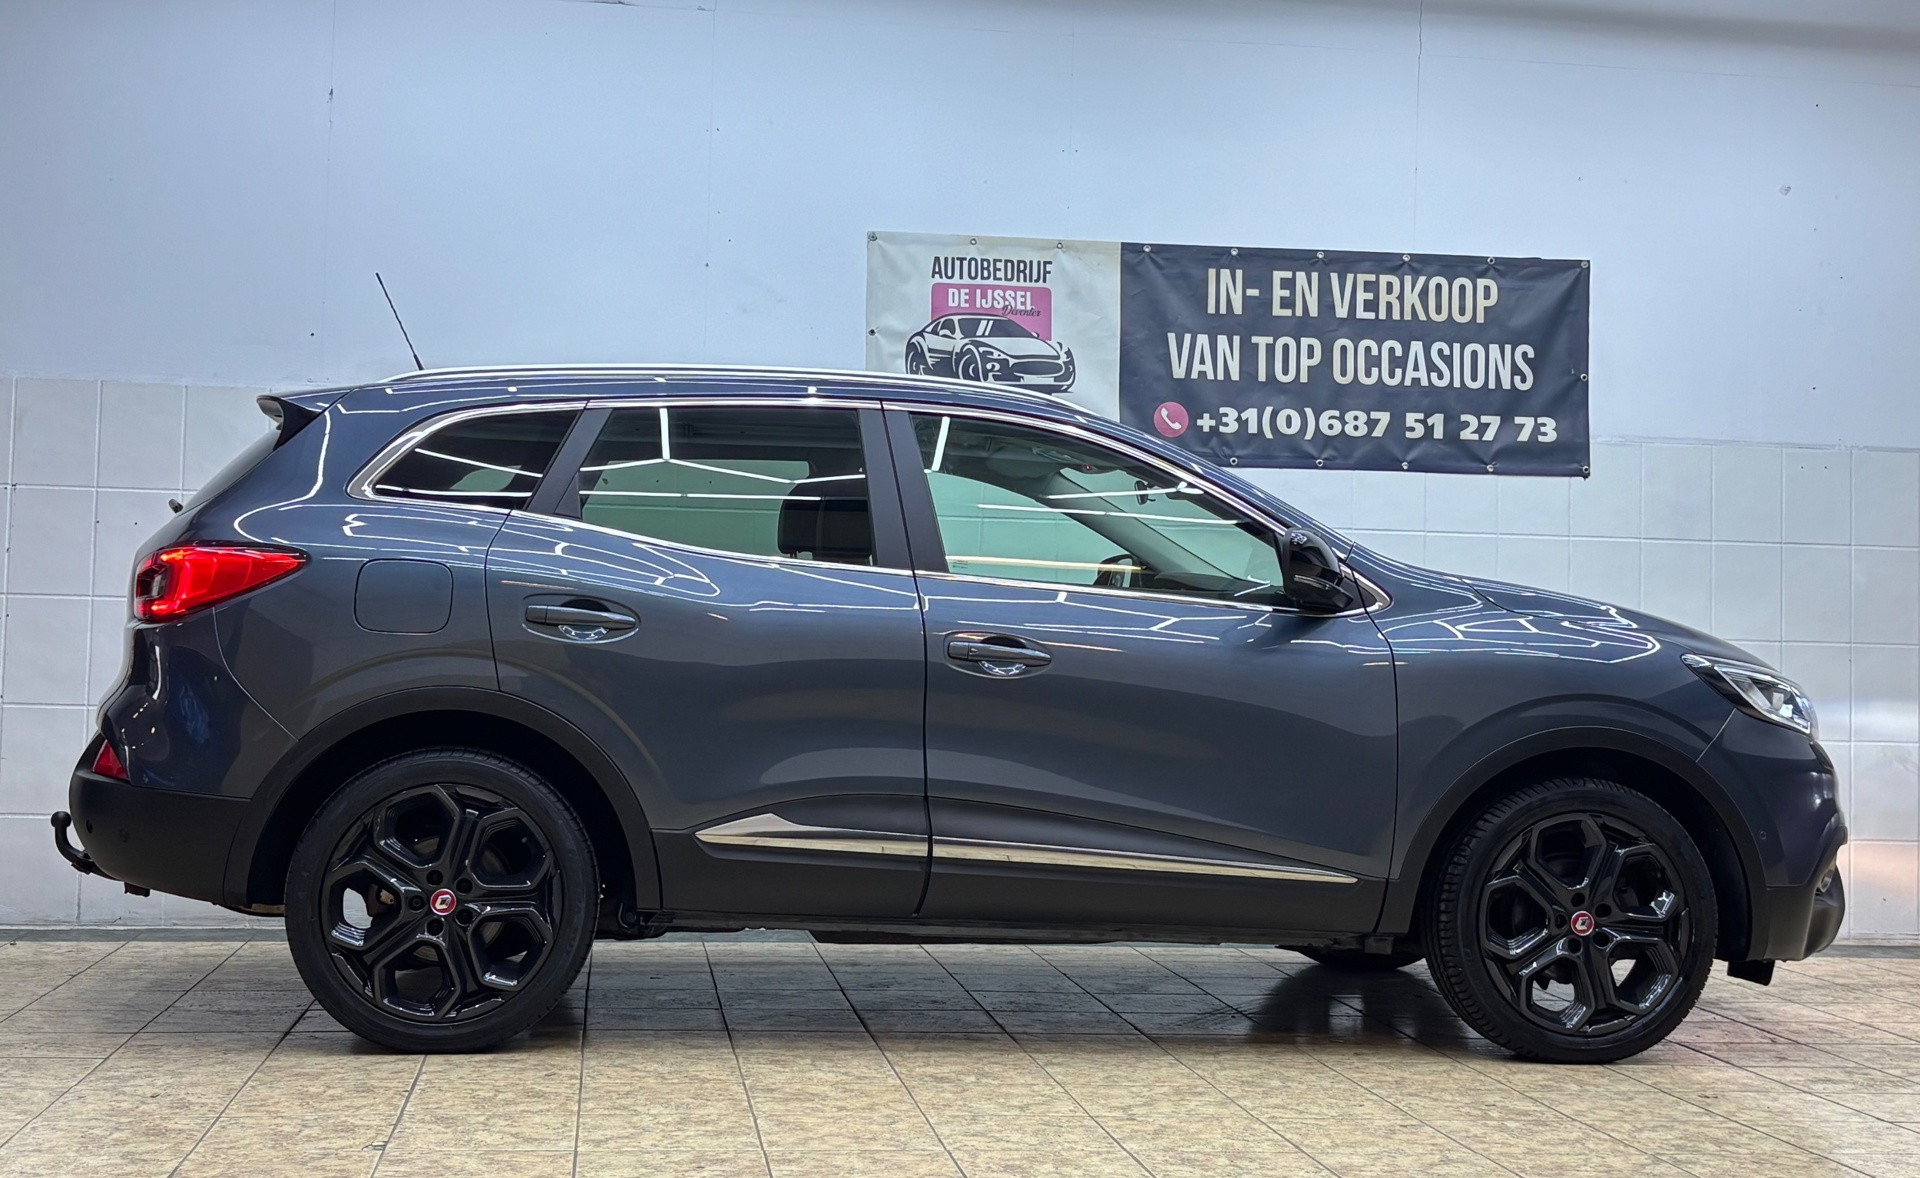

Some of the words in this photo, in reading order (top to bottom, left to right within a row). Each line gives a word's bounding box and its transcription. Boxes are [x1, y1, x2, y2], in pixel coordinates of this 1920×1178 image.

[931, 256, 1053, 283] AUTOBEDRIJF
[948, 288, 969, 308] DE
[975, 289, 1034, 310] IJSSEL
[1207, 268, 1260, 315] IN-
[1272, 270, 1319, 318] EN
[1330, 272, 1498, 323] VERKOOP
[1167, 332, 1241, 381] VAN
[1251, 335, 1322, 383] TOP
[1332, 337, 1535, 391] OCCASIONS
[1196, 406, 1391, 440] +31(0)687
[1405, 412, 1444, 439] 51
[1460, 414, 1501, 441] 27
[1514, 416, 1558, 443] 73
